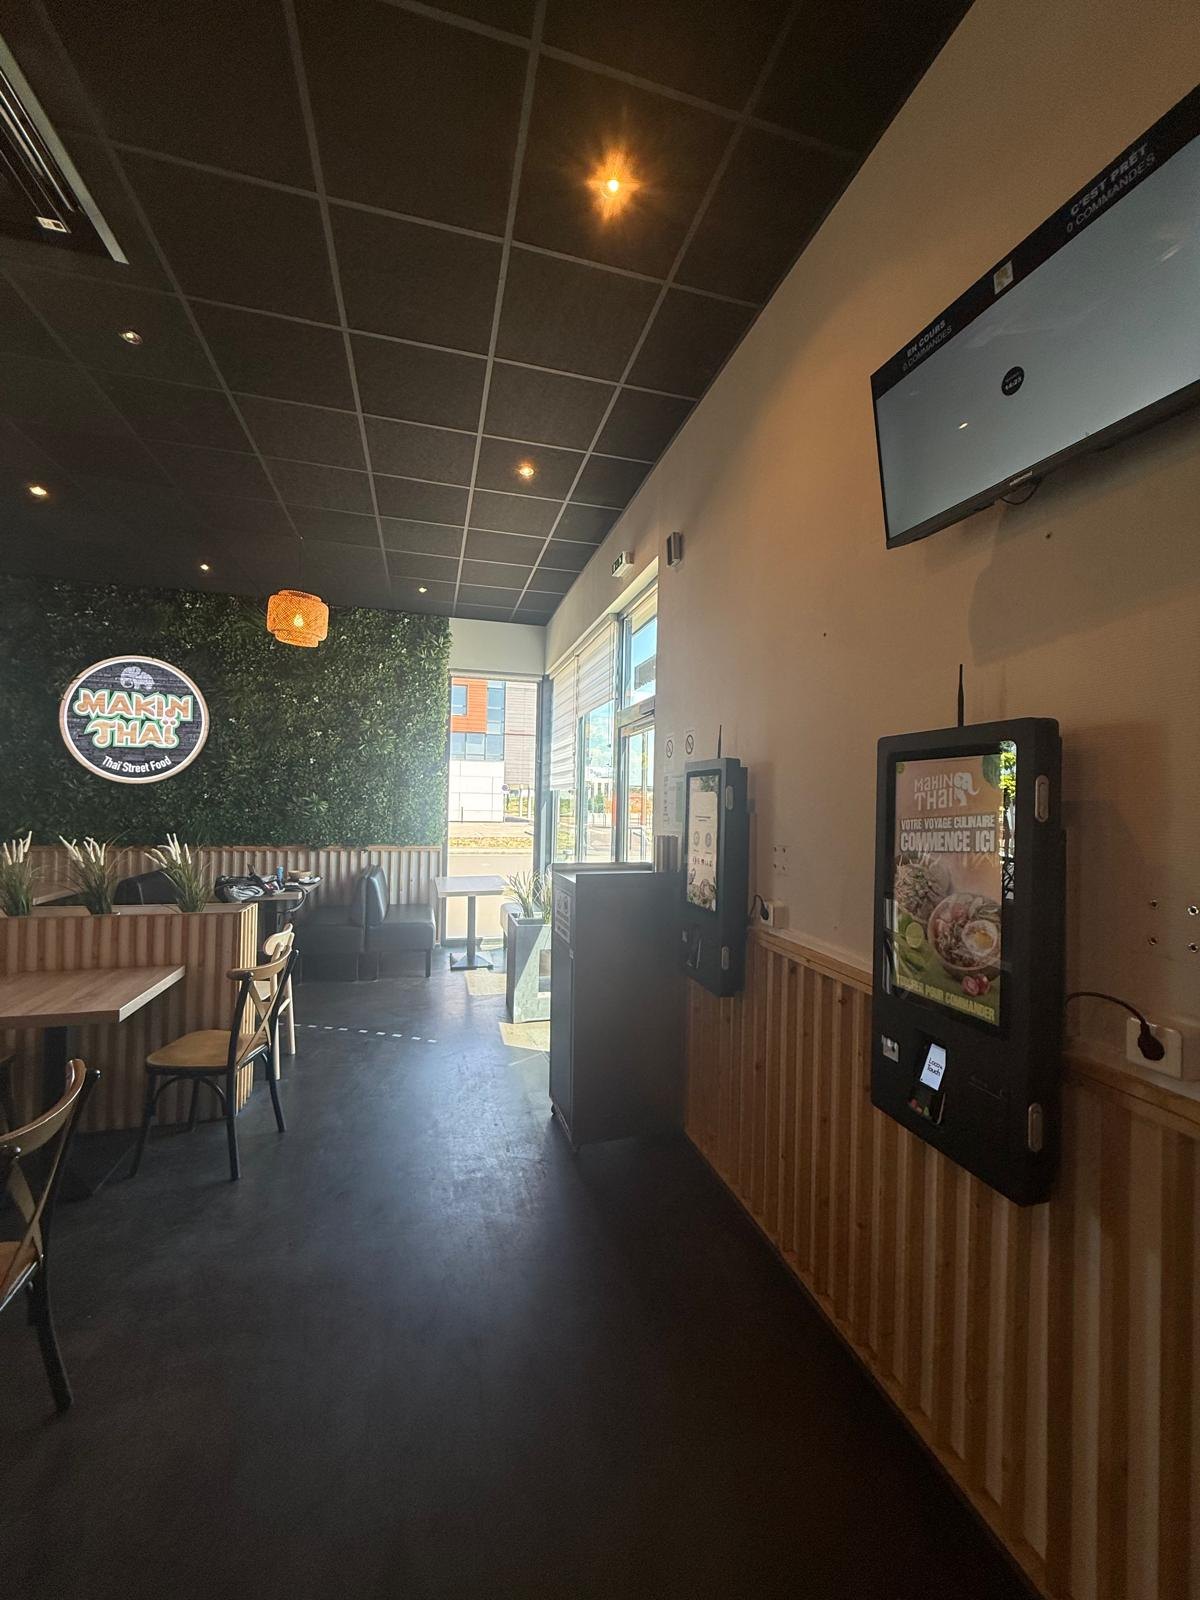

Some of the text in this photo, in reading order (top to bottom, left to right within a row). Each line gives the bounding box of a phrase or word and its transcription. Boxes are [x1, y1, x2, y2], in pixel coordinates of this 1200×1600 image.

[1076, 152, 1156, 226] COMMANDES
[918, 319, 946, 348] COURS
[74, 689, 193, 721] MAKIN
[102, 755, 173, 774] Thaï Street Food
[901, 814, 995, 831] VOTRE VOYAGE CULINAIRE
[900, 829, 996, 852] COMMENCE ICI
[927, 1063, 941, 1077] Touch
